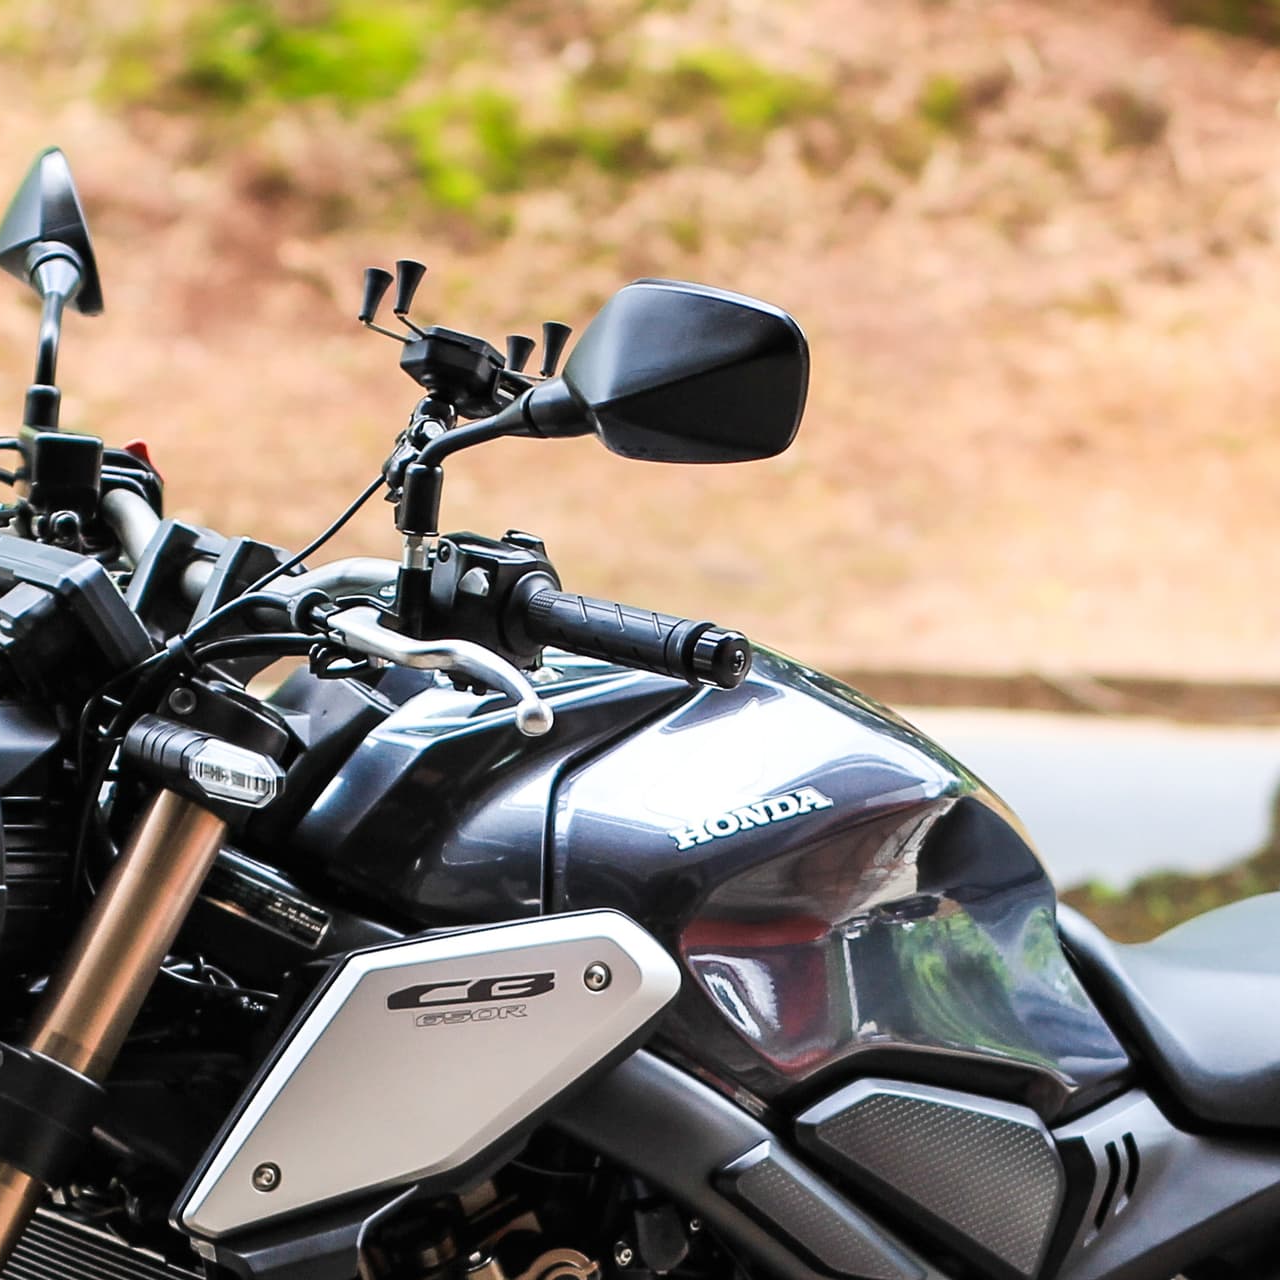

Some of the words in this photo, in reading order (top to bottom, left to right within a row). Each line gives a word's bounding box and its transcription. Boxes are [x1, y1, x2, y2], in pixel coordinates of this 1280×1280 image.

[668, 786, 833, 850] HONDA
[387, 972, 555, 1010] CB
[416, 1004, 528, 1027] 650R
